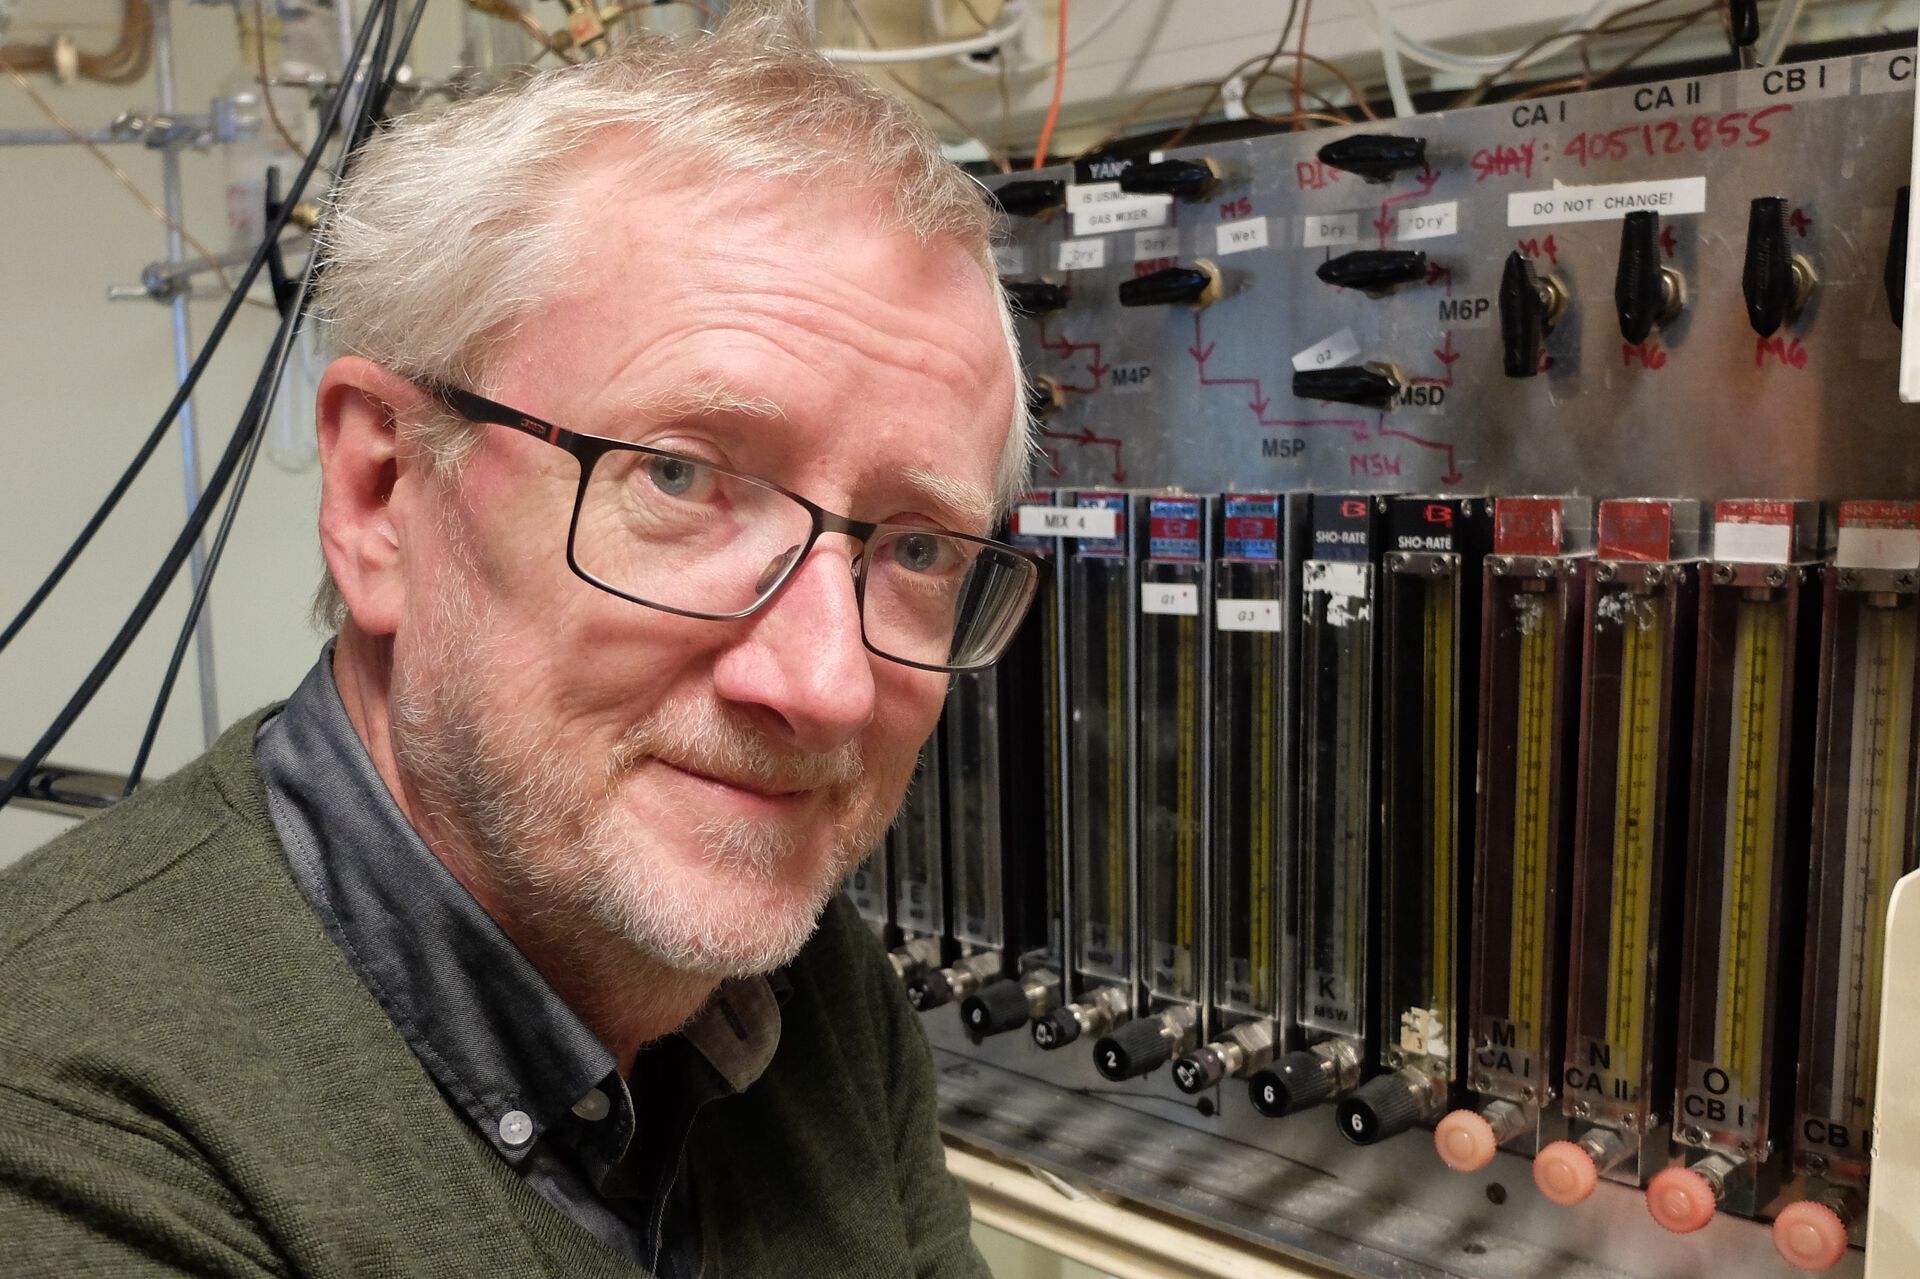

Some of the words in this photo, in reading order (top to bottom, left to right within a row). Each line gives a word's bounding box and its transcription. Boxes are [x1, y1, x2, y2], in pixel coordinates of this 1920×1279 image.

[1763, 69, 1806, 96] CB
[1819, 66, 1826, 88] I
[1634, 89, 1677, 112] CA
[1512, 105, 1550, 129] CA
[1559, 104, 1566, 123] I
[1533, 202, 1554, 216] DO
[1564, 199, 1595, 214] NOT
[1604, 192, 1674, 211] CHANGE!
[1088, 211, 1112, 226] GAS
[1116, 208, 1149, 223] MIXER
[1438, 298, 1490, 321] M6P
[1622, 342, 1667, 370] M6
[1756, 337, 1808, 369] M6
[1112, 367, 1151, 386] M4P
[1261, 437, 1306, 459] M5P
[1045, 514, 1068, 528] MIX
[1077, 517, 1085, 529] 4
[1315, 530, 1367, 545] SHO-RATE
[1398, 536, 1452, 551] SHO-RATE
[1319, 975, 1336, 998] K
[1492, 1021, 1516, 1049] M
[1106, 1050, 1117, 1069] 2
[1478, 1049, 1514, 1074] CA
[1589, 1044, 1610, 1070] N
[1565, 1062, 1602, 1094] CA
[1703, 1068, 1730, 1095] O
[1263, 1085, 1275, 1103] 6
[1352, 1113, 1364, 1132] 6
[1684, 1096, 1727, 1123] CB
[1737, 1104, 1745, 1126] I
[1803, 1119, 1849, 1149] CB
